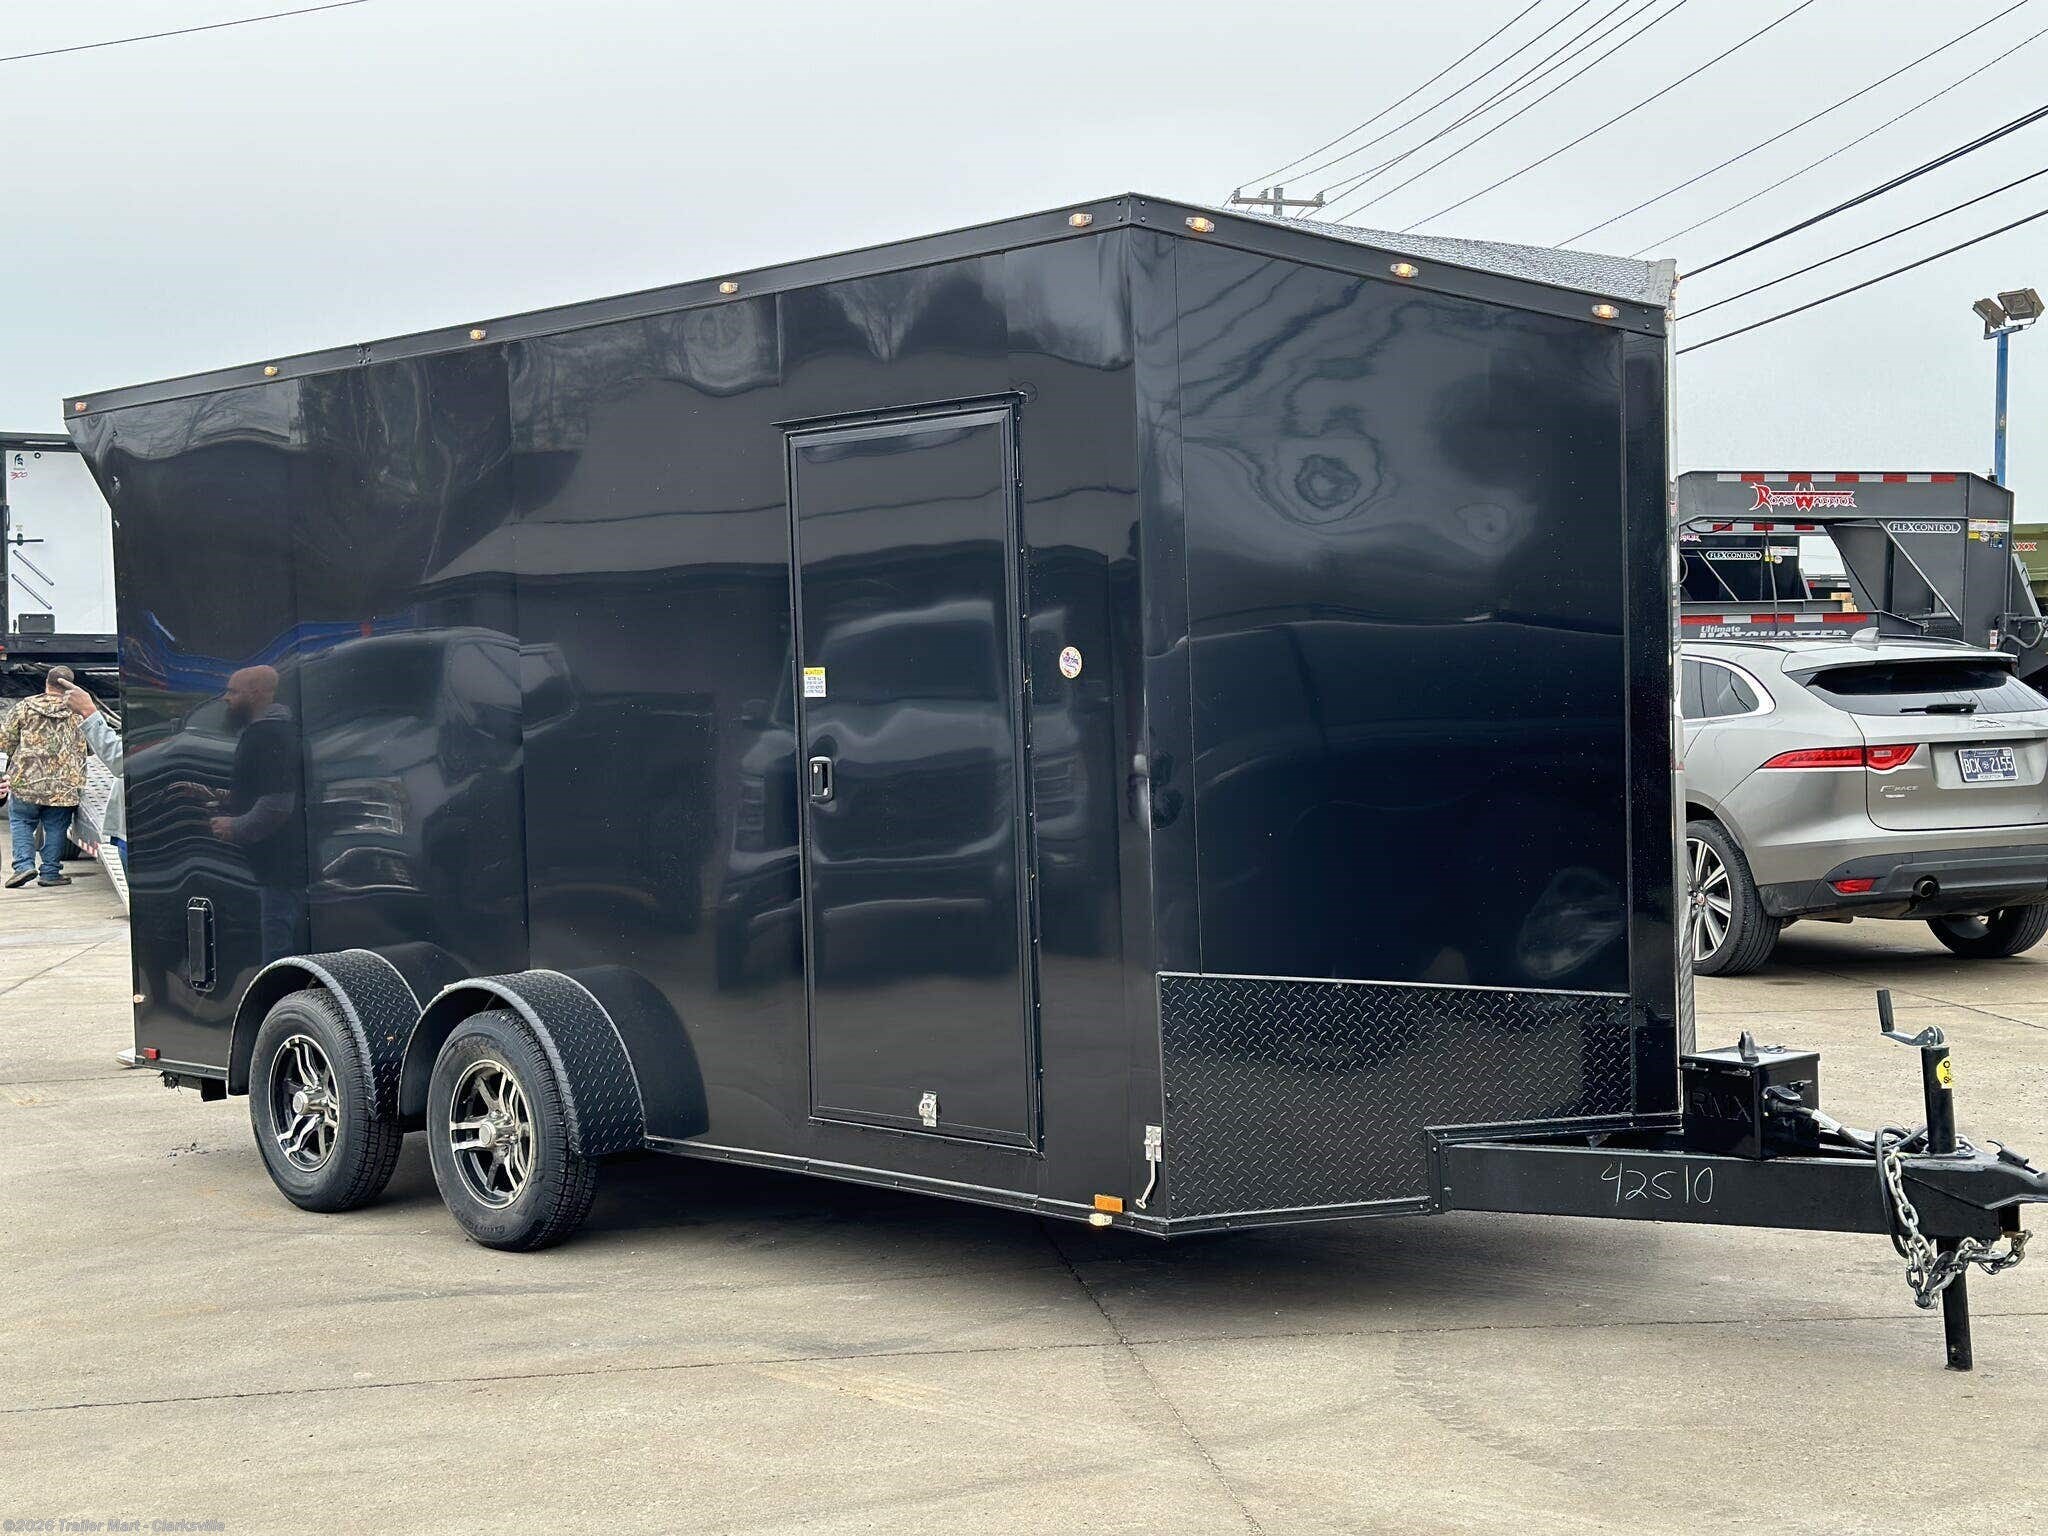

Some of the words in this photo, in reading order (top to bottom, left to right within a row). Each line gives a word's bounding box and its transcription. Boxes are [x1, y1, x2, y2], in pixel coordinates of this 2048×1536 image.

[1701, 624, 1741, 633] Ultimate
[1963, 758, 1983, 773] BCK
[1989, 756, 2014, 772] 2155
